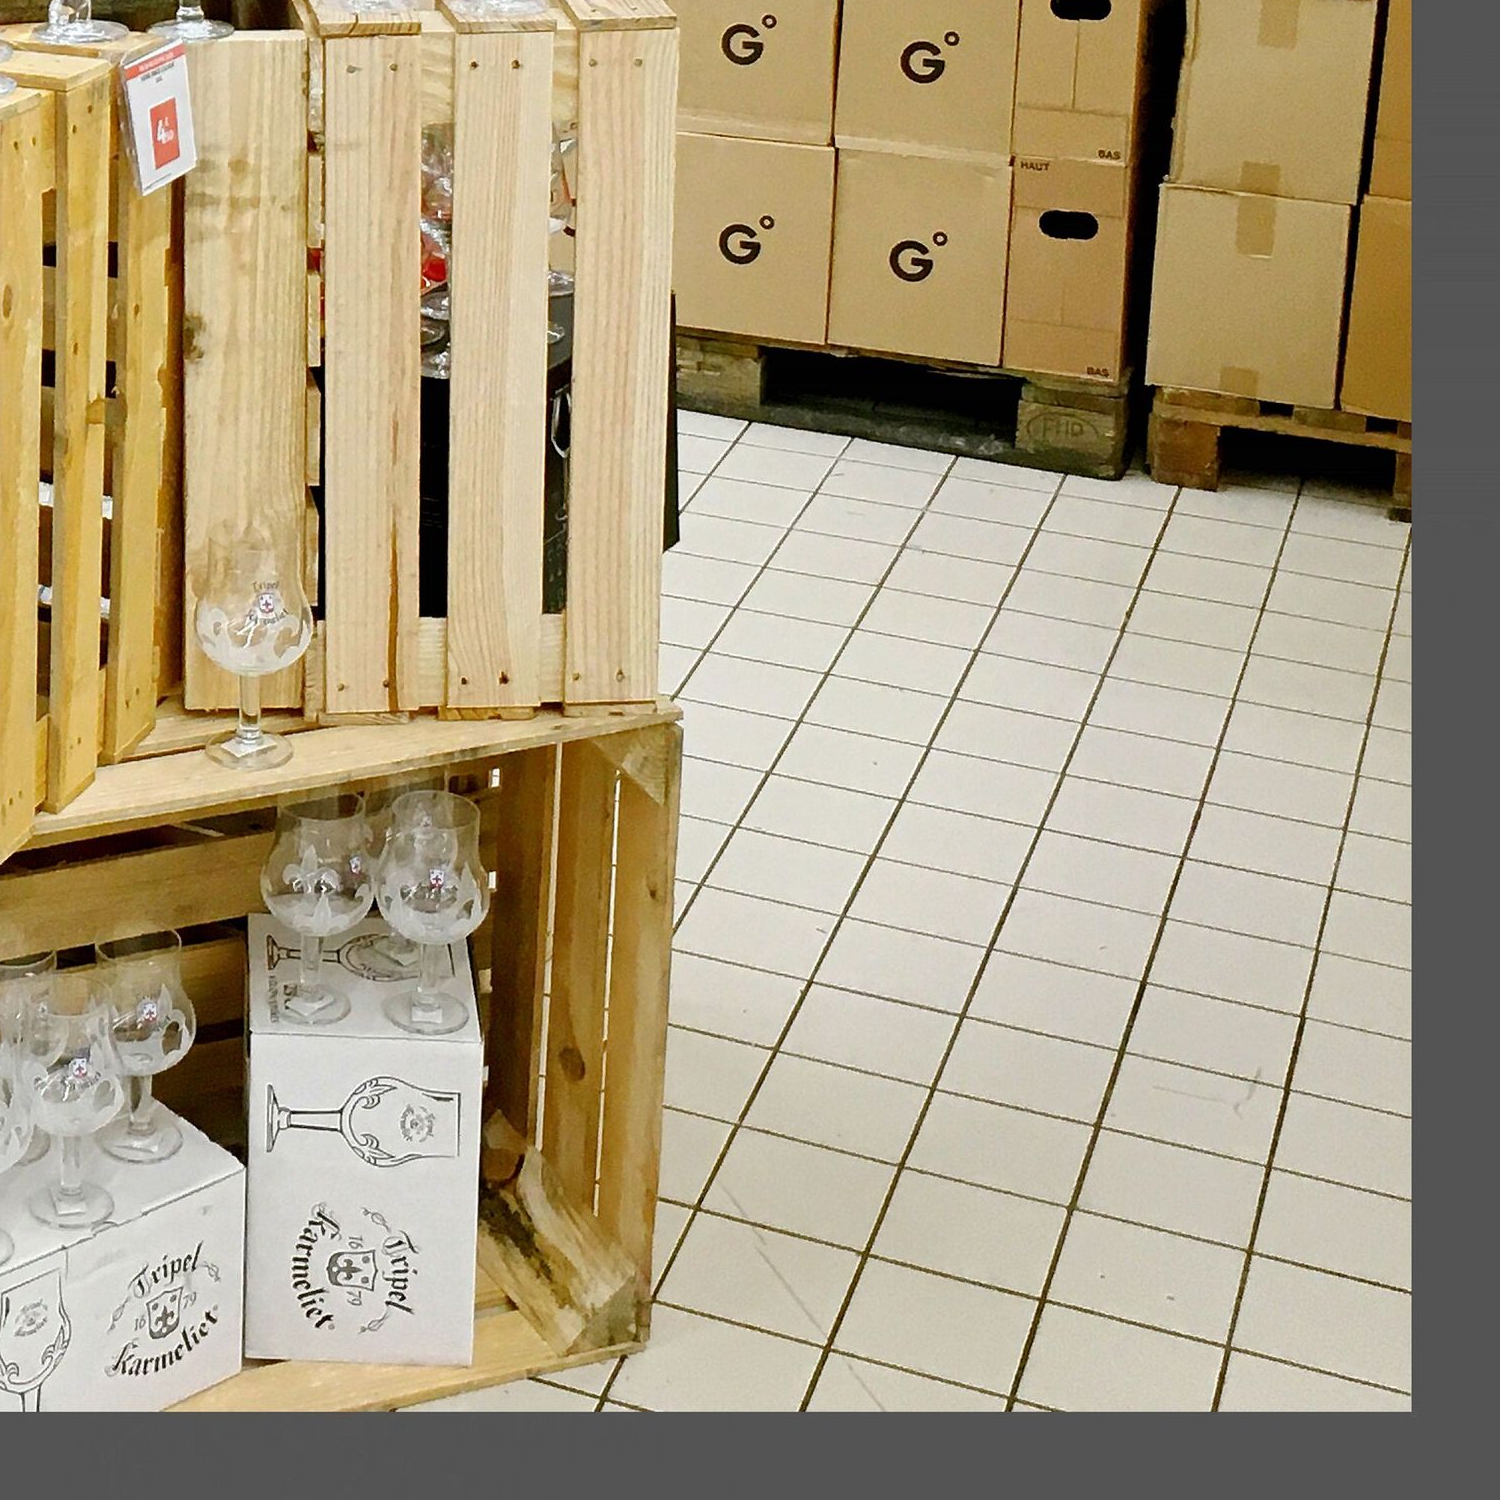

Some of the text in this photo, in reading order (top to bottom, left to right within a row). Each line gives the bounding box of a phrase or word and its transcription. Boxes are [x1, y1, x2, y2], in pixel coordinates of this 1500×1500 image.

[1098, 149, 1121, 160] BAS
[348, 1236, 363, 1249] 16
[131, 1241, 204, 1299] Tripel
[291, 1202, 342, 1331] Karmeliet
[382, 1229, 419, 1315] Tripel
[182, 1292, 197, 1308] 79
[346, 1291, 362, 1306] 79
[134, 1317, 146, 1331] 16
[104, 1307, 219, 1377] Karmeliet
